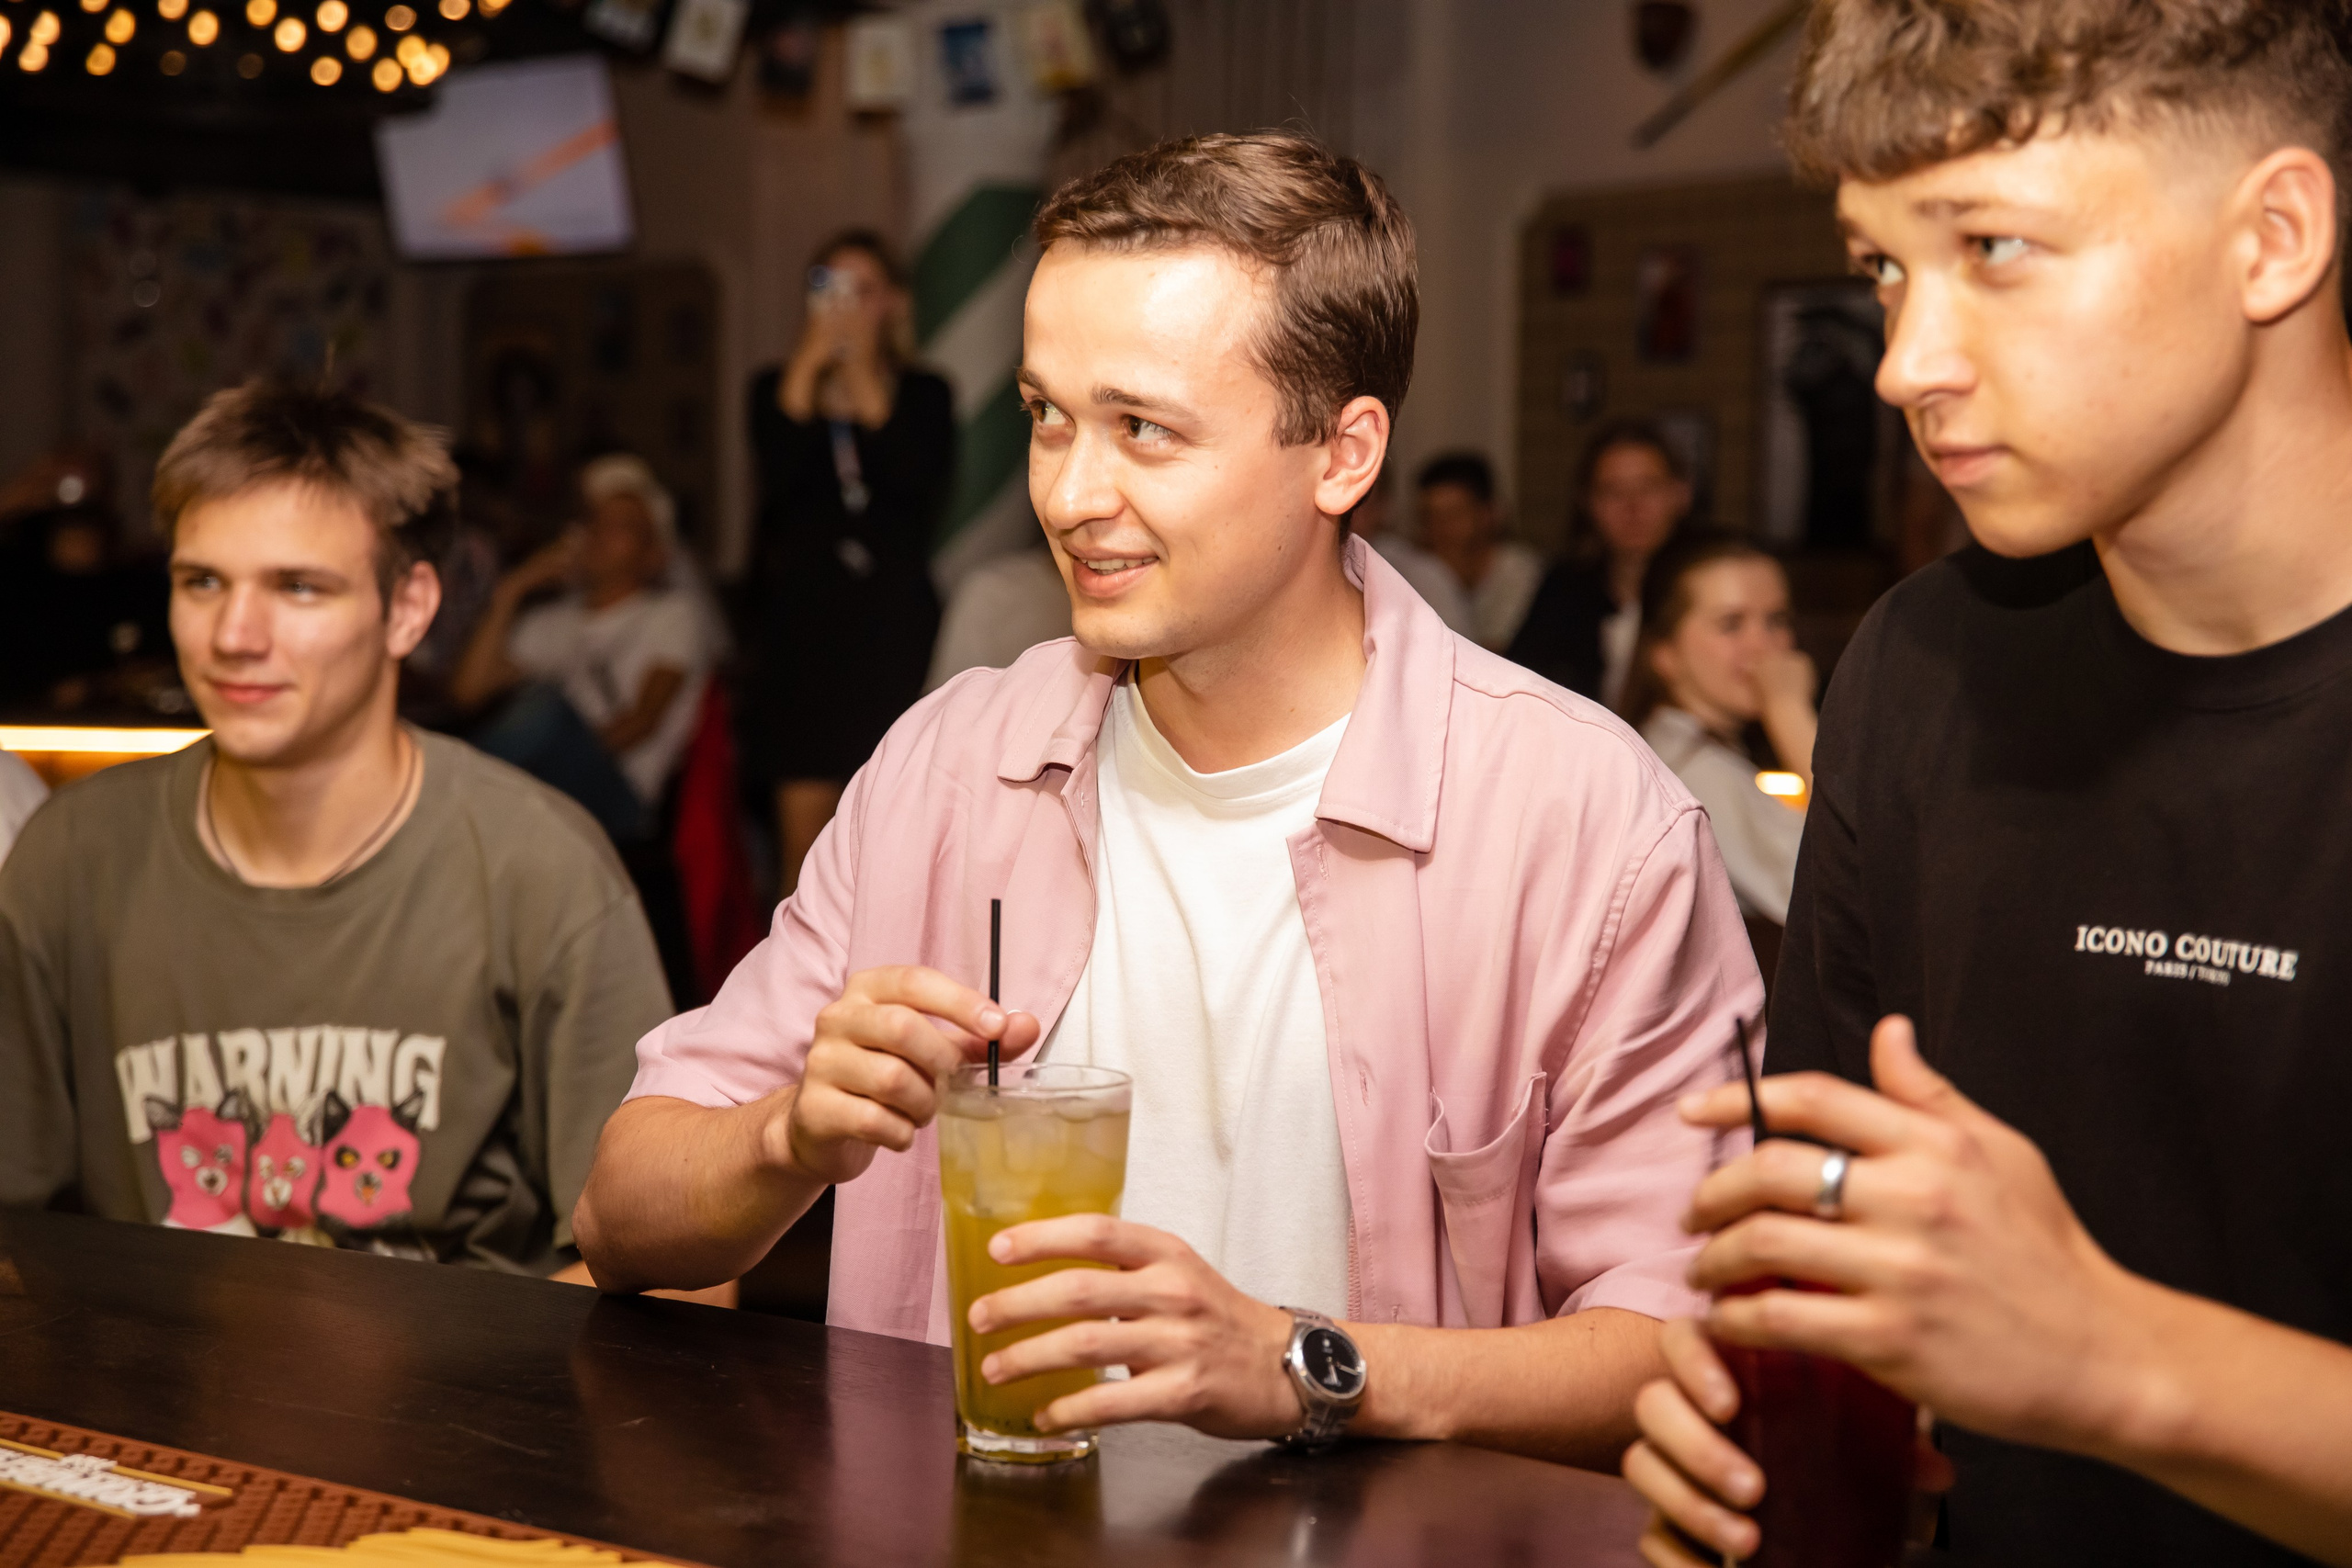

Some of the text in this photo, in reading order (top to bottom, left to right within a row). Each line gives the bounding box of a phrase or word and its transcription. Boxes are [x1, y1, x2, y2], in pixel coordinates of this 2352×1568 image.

[2074, 924, 2299, 983] ICONO COUTURE
[116, 1023, 447, 1145] WARNING
